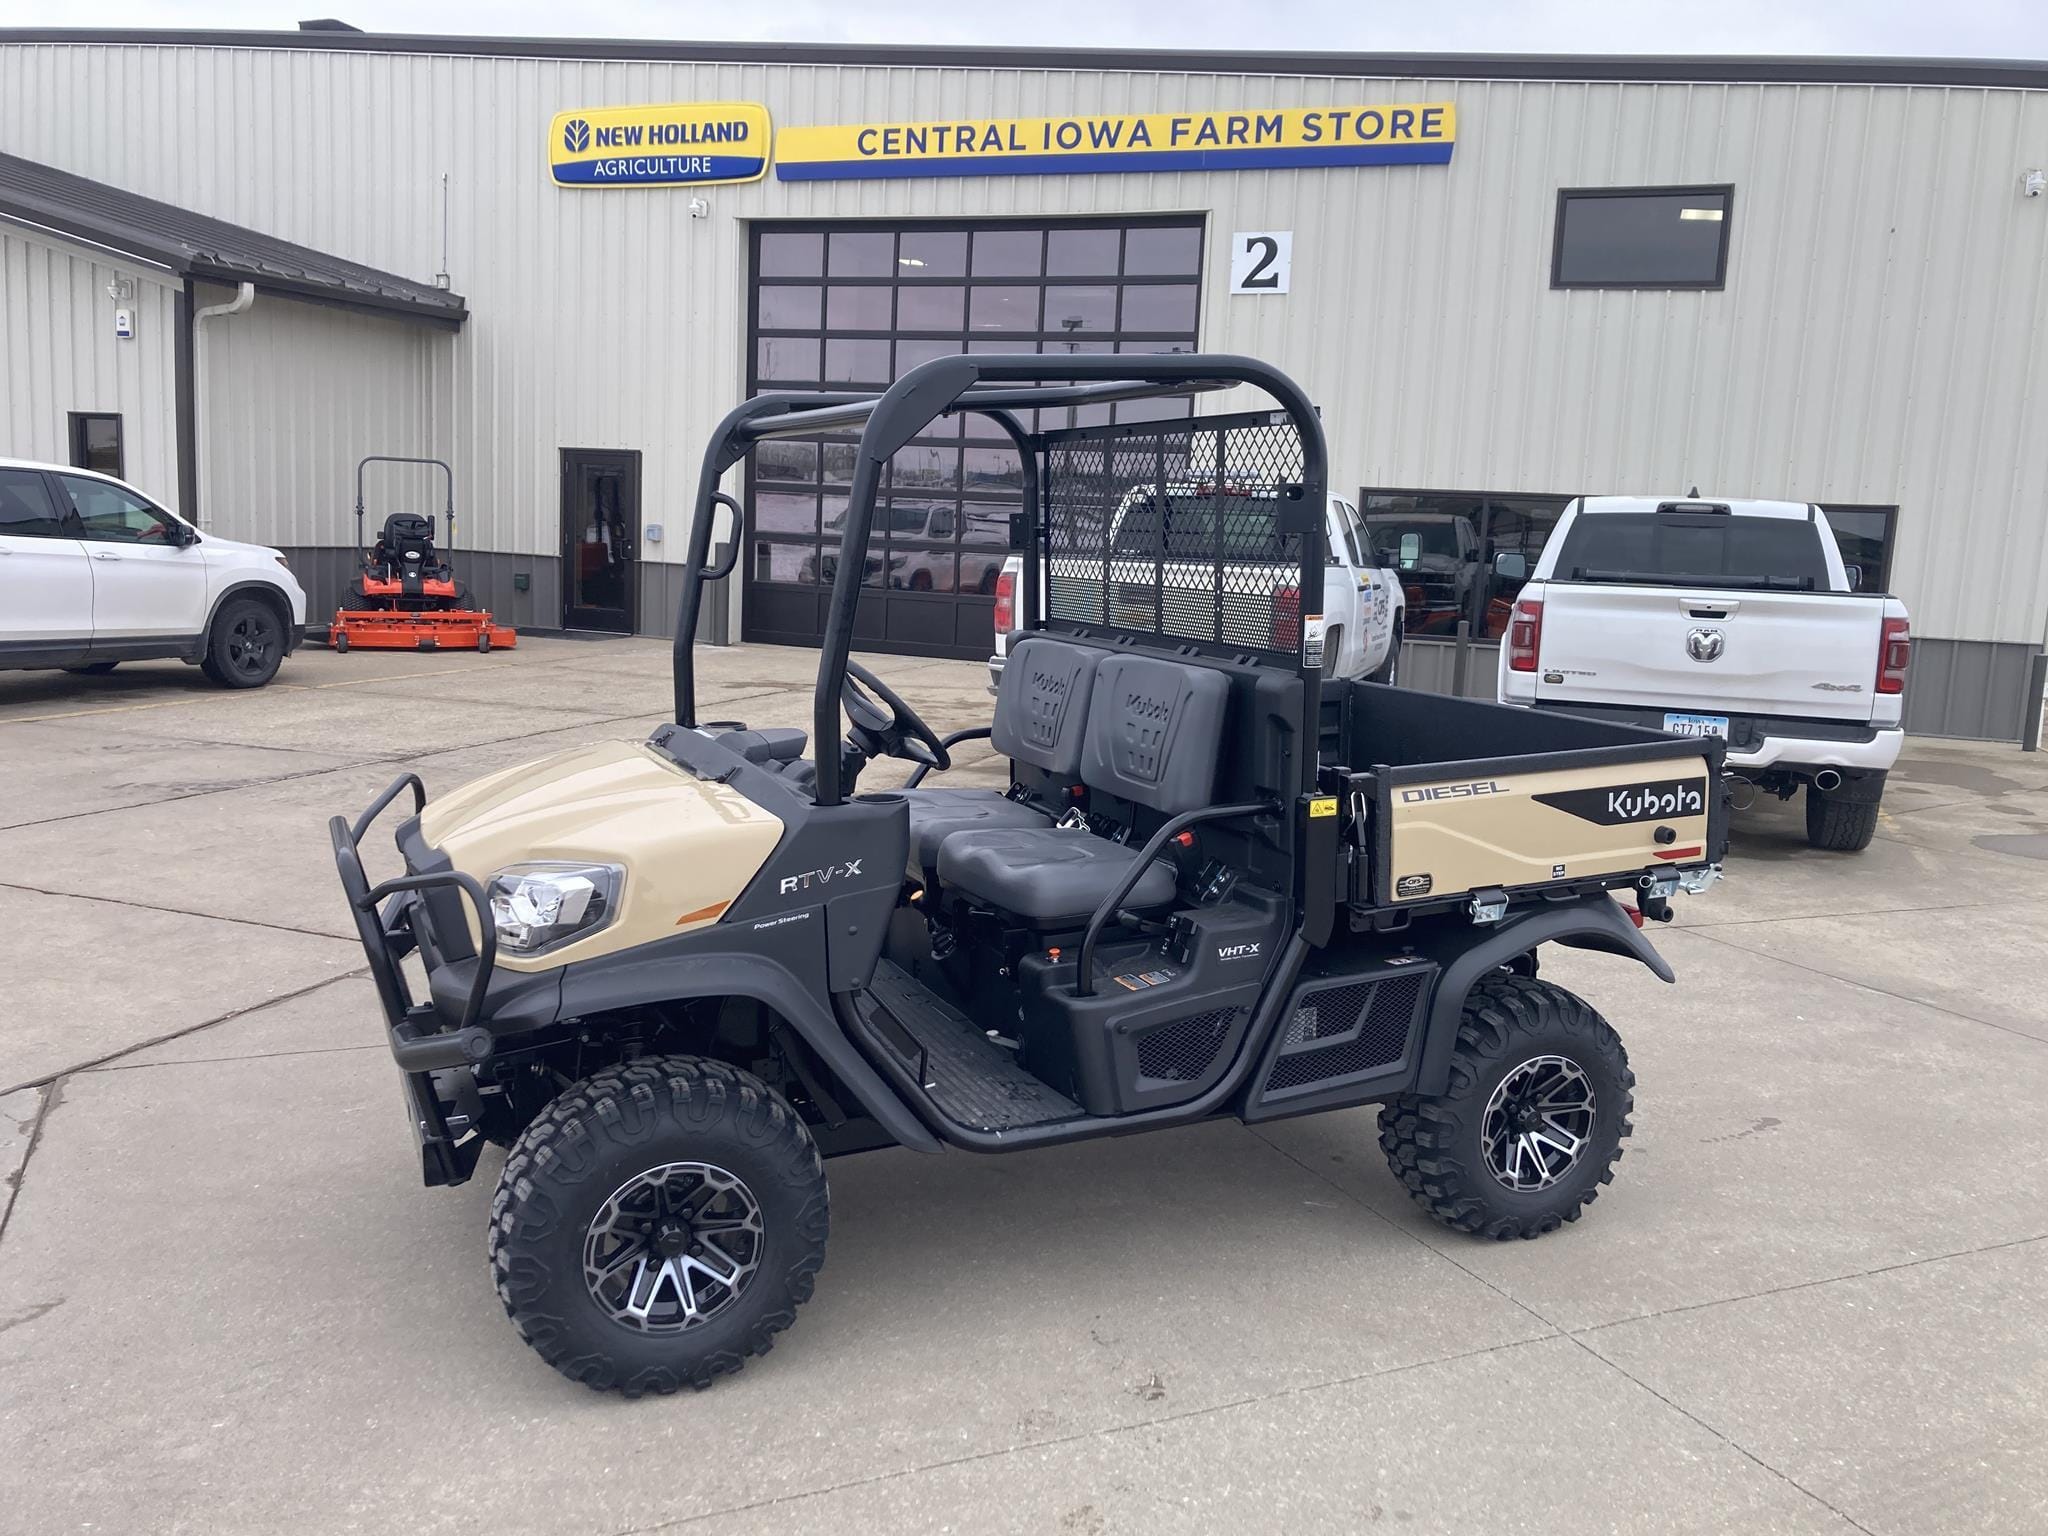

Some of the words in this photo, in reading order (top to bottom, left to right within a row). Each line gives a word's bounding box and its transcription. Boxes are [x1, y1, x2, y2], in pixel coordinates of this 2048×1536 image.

[595, 124, 643, 148] NEW
[648, 120, 748, 145] HOLLAND
[857, 120, 1027, 156] CENTRAL
[1043, 119, 1152, 151] IOWA
[1170, 114, 1283, 146] FARM
[1302, 107, 1444, 142] STORE
[594, 156, 711, 177] AGRICULTURE
[1240, 236, 1280, 289] 2
[1402, 781, 1510, 803] DIESEL
[1608, 785, 1701, 818] Kubota
[780, 858, 863, 895] RTV-X
[754, 920, 778, 930] Power
[777, 912, 810, 924] Steering
[1218, 942, 1260, 957] VHT-X
